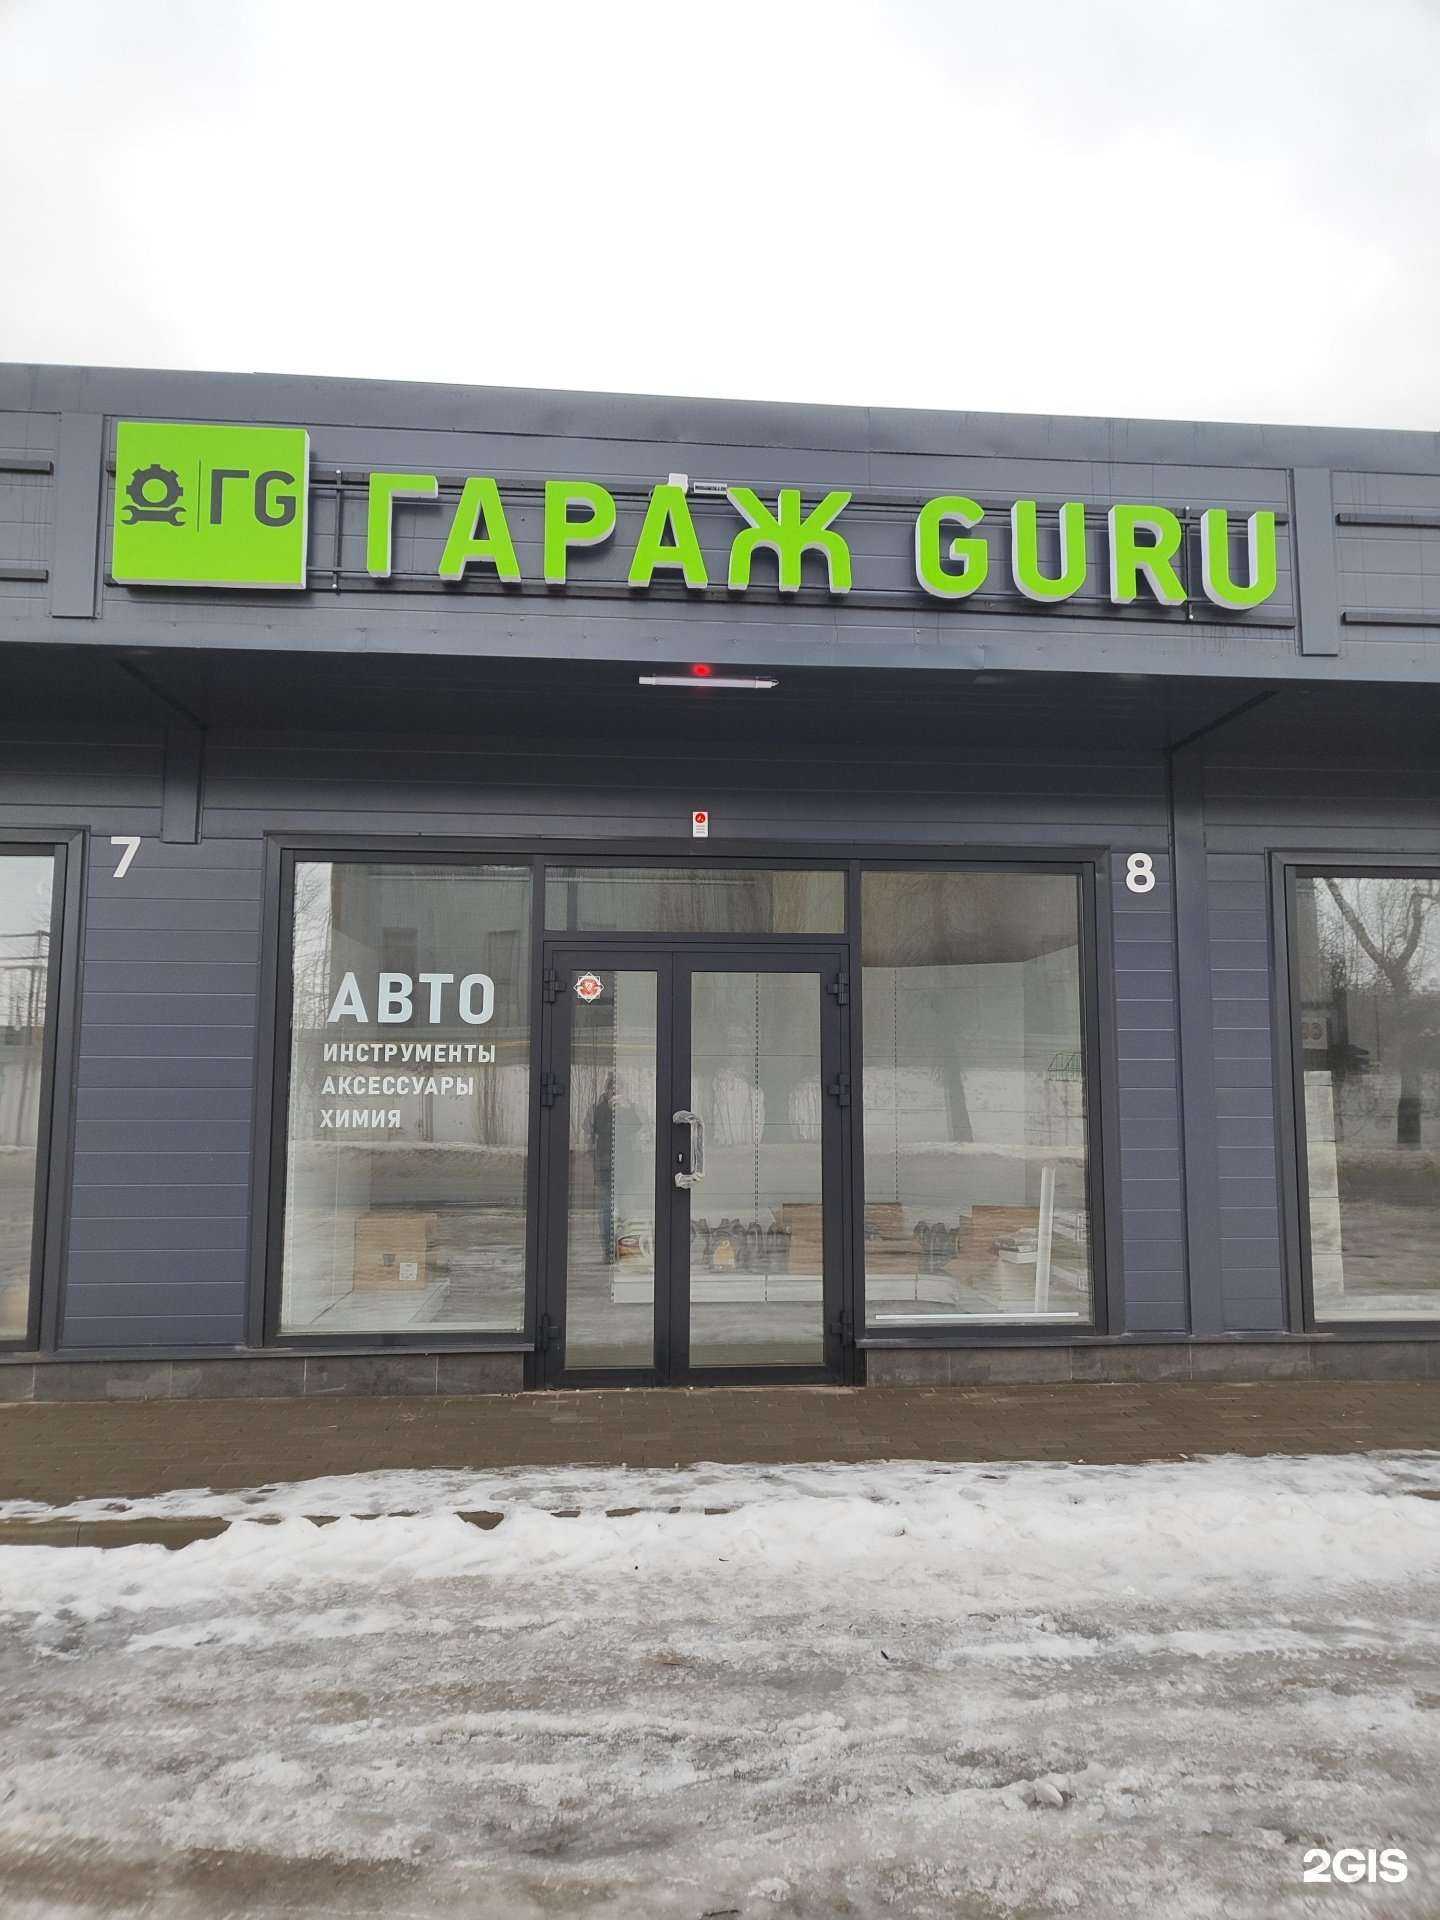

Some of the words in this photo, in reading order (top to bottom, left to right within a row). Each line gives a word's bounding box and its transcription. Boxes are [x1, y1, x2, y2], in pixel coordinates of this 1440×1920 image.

[367, 473, 852, 594] ГАРАЖ
[915, 496, 1278, 611] GURU
[110, 836, 141, 878] 7
[1125, 853, 1156, 894] 8
[327, 971, 495, 1025] АВТО
[322, 1043, 496, 1064] ИНСТРУМЕНТЫ
[320, 1076, 474, 1096] АКСЕССУАРЫ
[319, 1109, 401, 1128] ХИМИЯ
